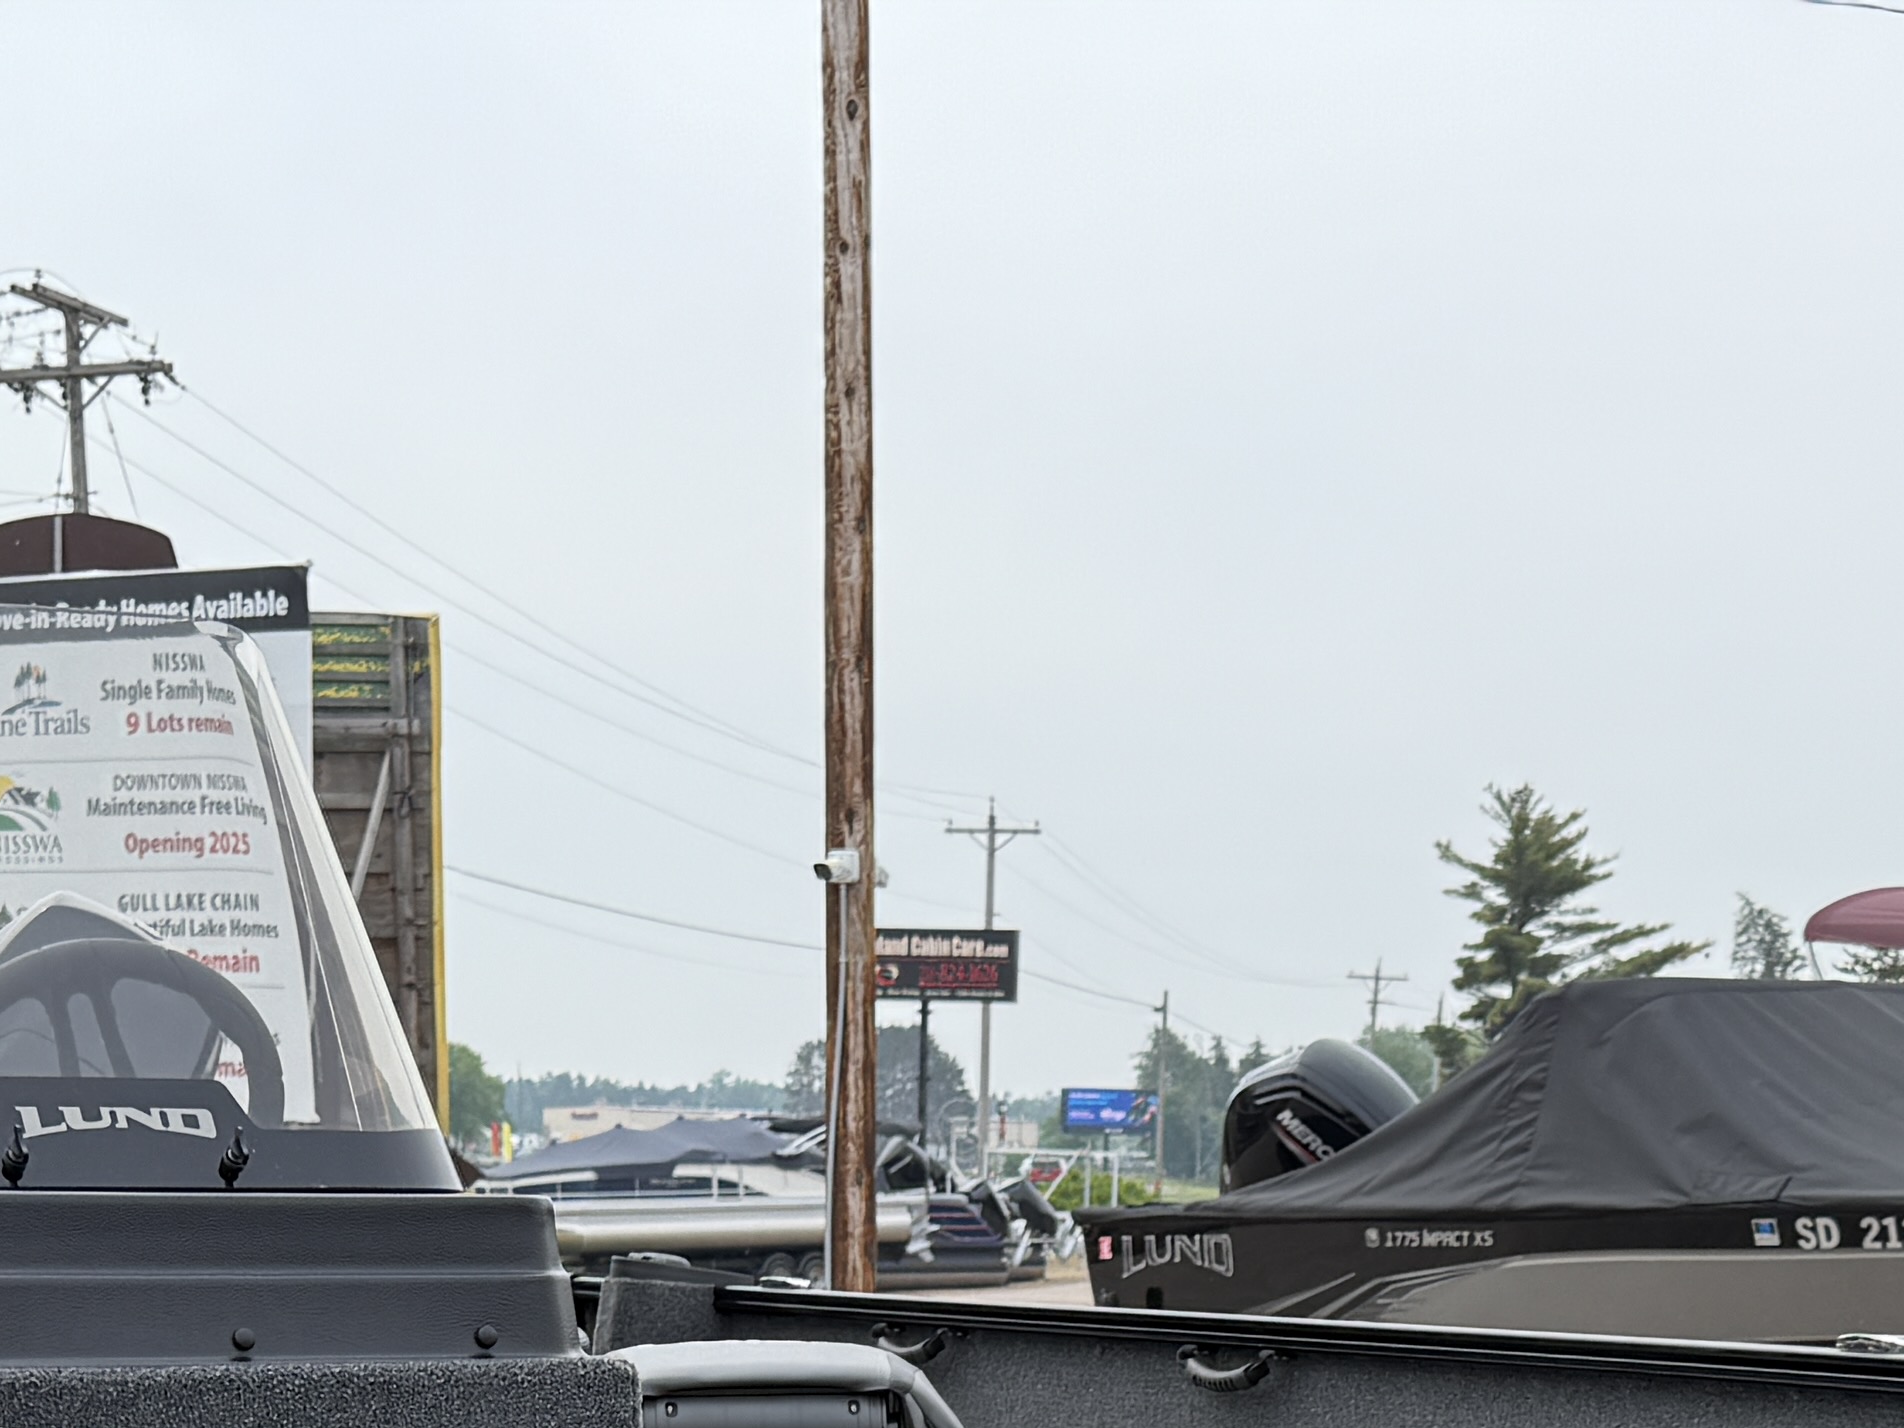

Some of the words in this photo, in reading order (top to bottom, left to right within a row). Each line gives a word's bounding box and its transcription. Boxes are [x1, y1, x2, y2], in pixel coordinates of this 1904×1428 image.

[192, 589, 289, 620] Available
[152, 652, 206, 673] NISSWA
[99, 680, 152, 706] Single
[155, 676, 204, 707] Family
[30, 707, 91, 736] Trails
[126, 711, 140, 736] 9
[146, 711, 184, 733] Lots
[187, 712, 234, 736] remain
[113, 773, 202, 793] DOWNTOWN
[86, 795, 197, 817] Maintenance
[200, 795, 233, 816] Free
[234, 797, 268, 825] Living
[124, 831, 205, 859] Opening
[208, 832, 251, 856] 2025
[117, 893, 160, 913] GULL
[163, 893, 205, 912] LAKE
[209, 893, 260, 912] CHAIN
[189, 918, 227, 938] Lake
[229, 918, 280, 939] Homes
[14, 1106, 217, 1139] LUND
[1274, 1108, 1338, 1162] MERC
[1385, 1231, 1420, 1248] 1775
[1473, 1230, 1494, 1247] XS
[1795, 1216, 1841, 1250] SD
[1121, 1233, 1235, 1279] LUND
